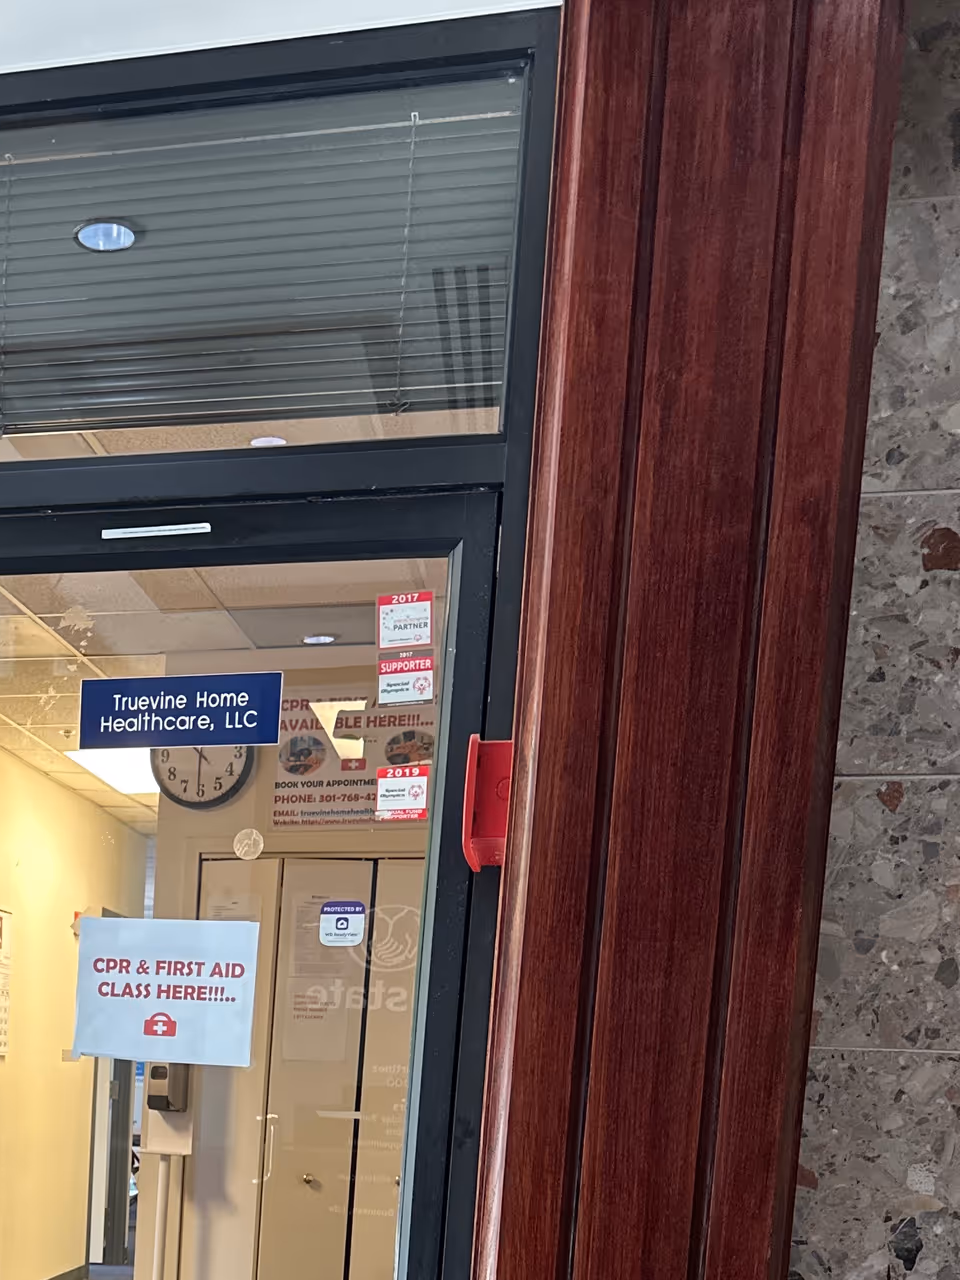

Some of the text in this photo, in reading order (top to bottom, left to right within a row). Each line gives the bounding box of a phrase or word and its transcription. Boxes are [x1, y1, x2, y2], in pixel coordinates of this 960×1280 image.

[392, 593, 419, 604] 2017
[393, 621, 429, 631] PARTNER
[381, 659, 431, 673] SUPPORTER
[113, 690, 249, 711] Truevine Home
[281, 699, 309, 711] CPR
[100, 710, 258, 733] Healthcare, LLC
[280, 716, 361, 732] AVAILBLE
[161, 748, 170, 763] 9
[168, 767, 176, 781] 8
[225, 762, 234, 776] 4
[387, 768, 420, 777] 2019
[181, 779, 189, 793] 7
[196, 784, 205, 797] 6
[213, 776, 223, 791] 5
[275, 781, 298, 789] BOOK
[301, 780, 324, 788] YOUR
[274, 794, 316, 804] PHONE:
[93, 957, 245, 979] CPR & FIRST AID
[98, 981, 151, 999] CLASS
